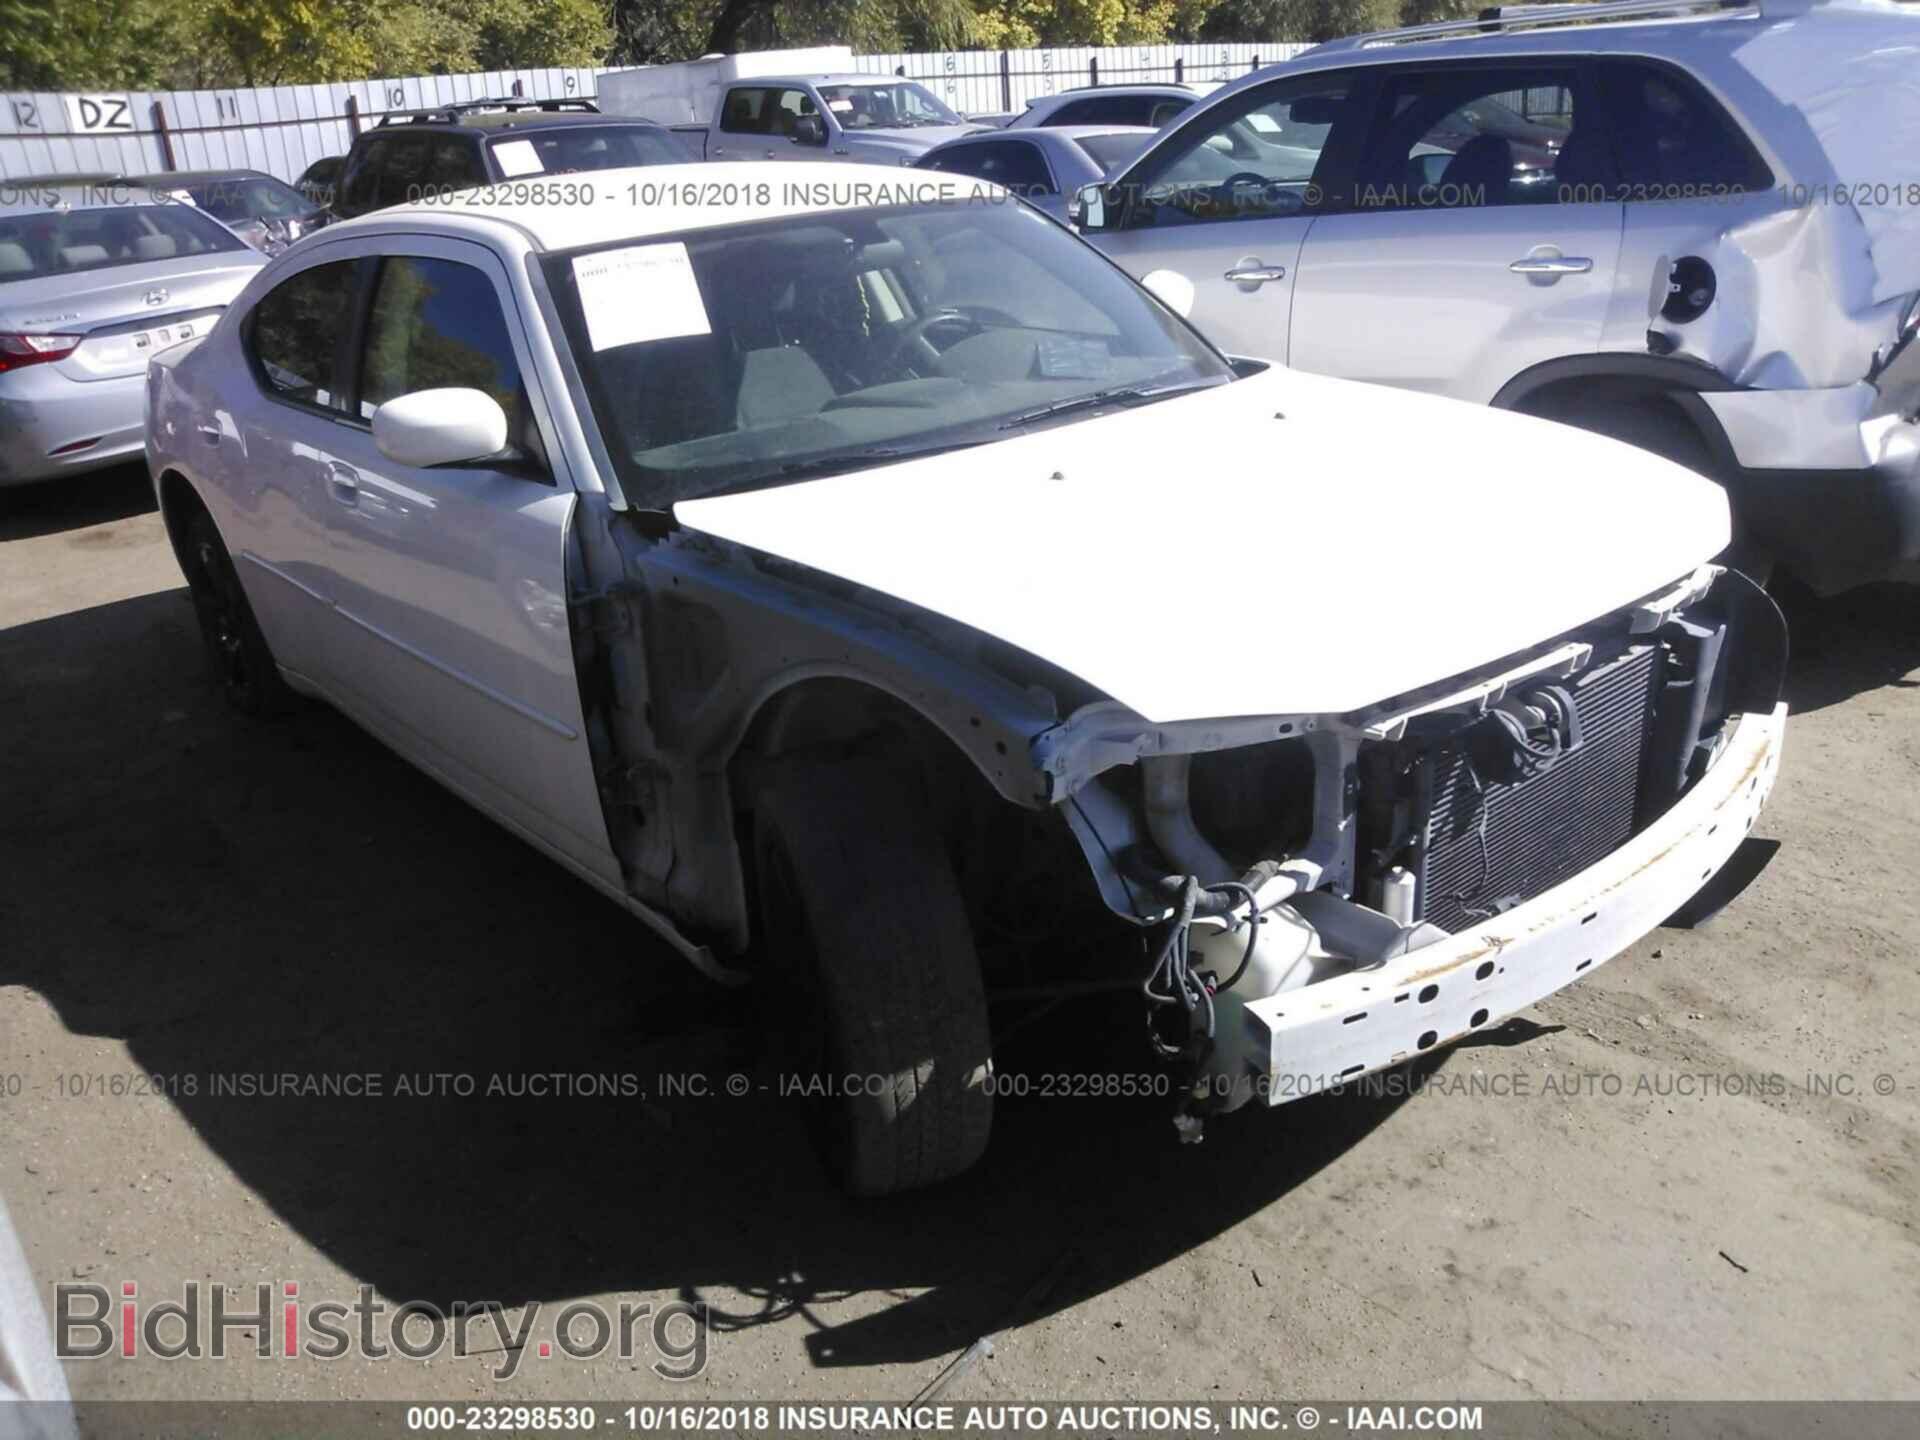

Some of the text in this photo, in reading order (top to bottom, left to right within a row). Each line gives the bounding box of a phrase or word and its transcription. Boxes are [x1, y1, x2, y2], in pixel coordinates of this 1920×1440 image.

[565, 76, 576, 94] 9
[217, 95, 237, 119] 11
[387, 87, 405, 109] 10
[13, 101, 39, 128] 12
